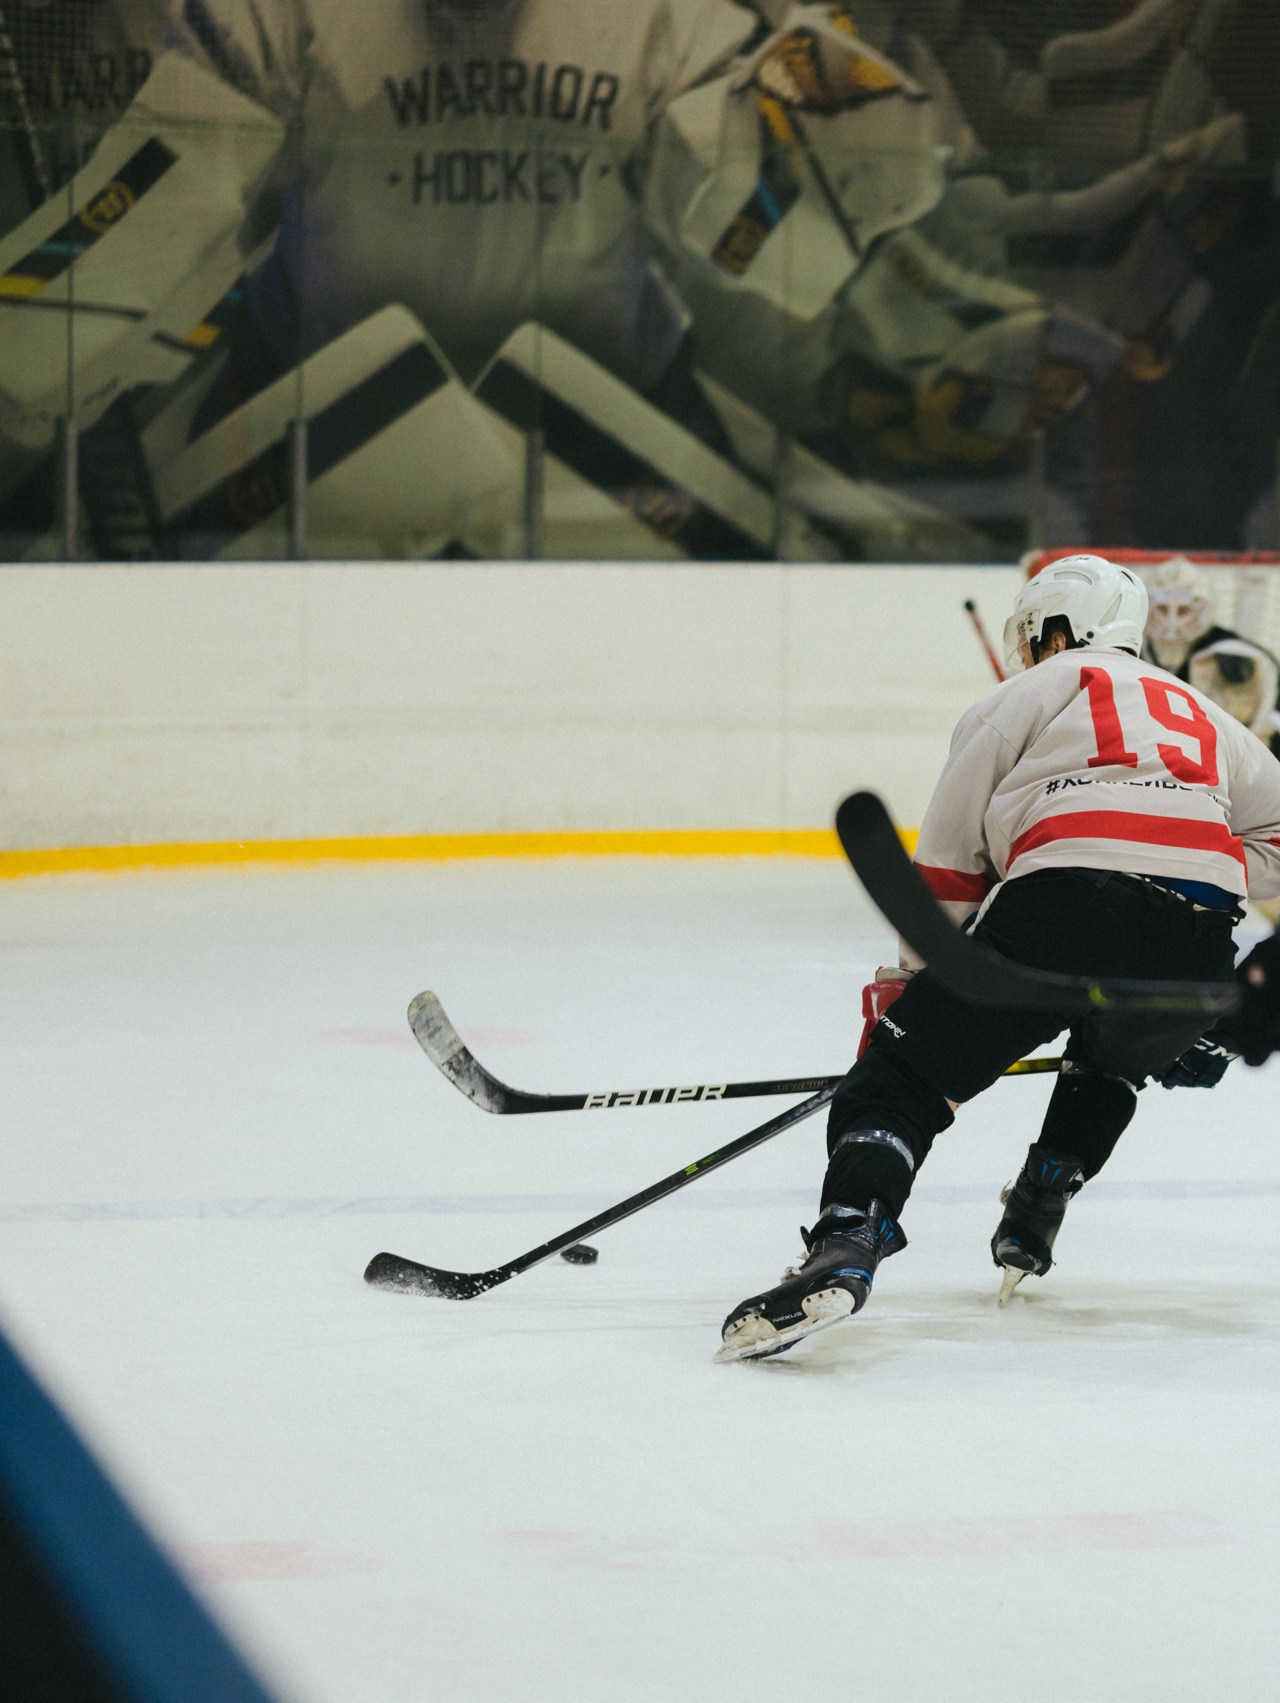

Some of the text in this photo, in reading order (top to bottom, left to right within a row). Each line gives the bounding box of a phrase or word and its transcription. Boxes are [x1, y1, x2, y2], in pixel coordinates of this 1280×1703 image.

[384, 59, 620, 131] WARRIOR
[1080, 667, 1220, 786] 19
[773, 1311, 803, 1324] NEXUS
